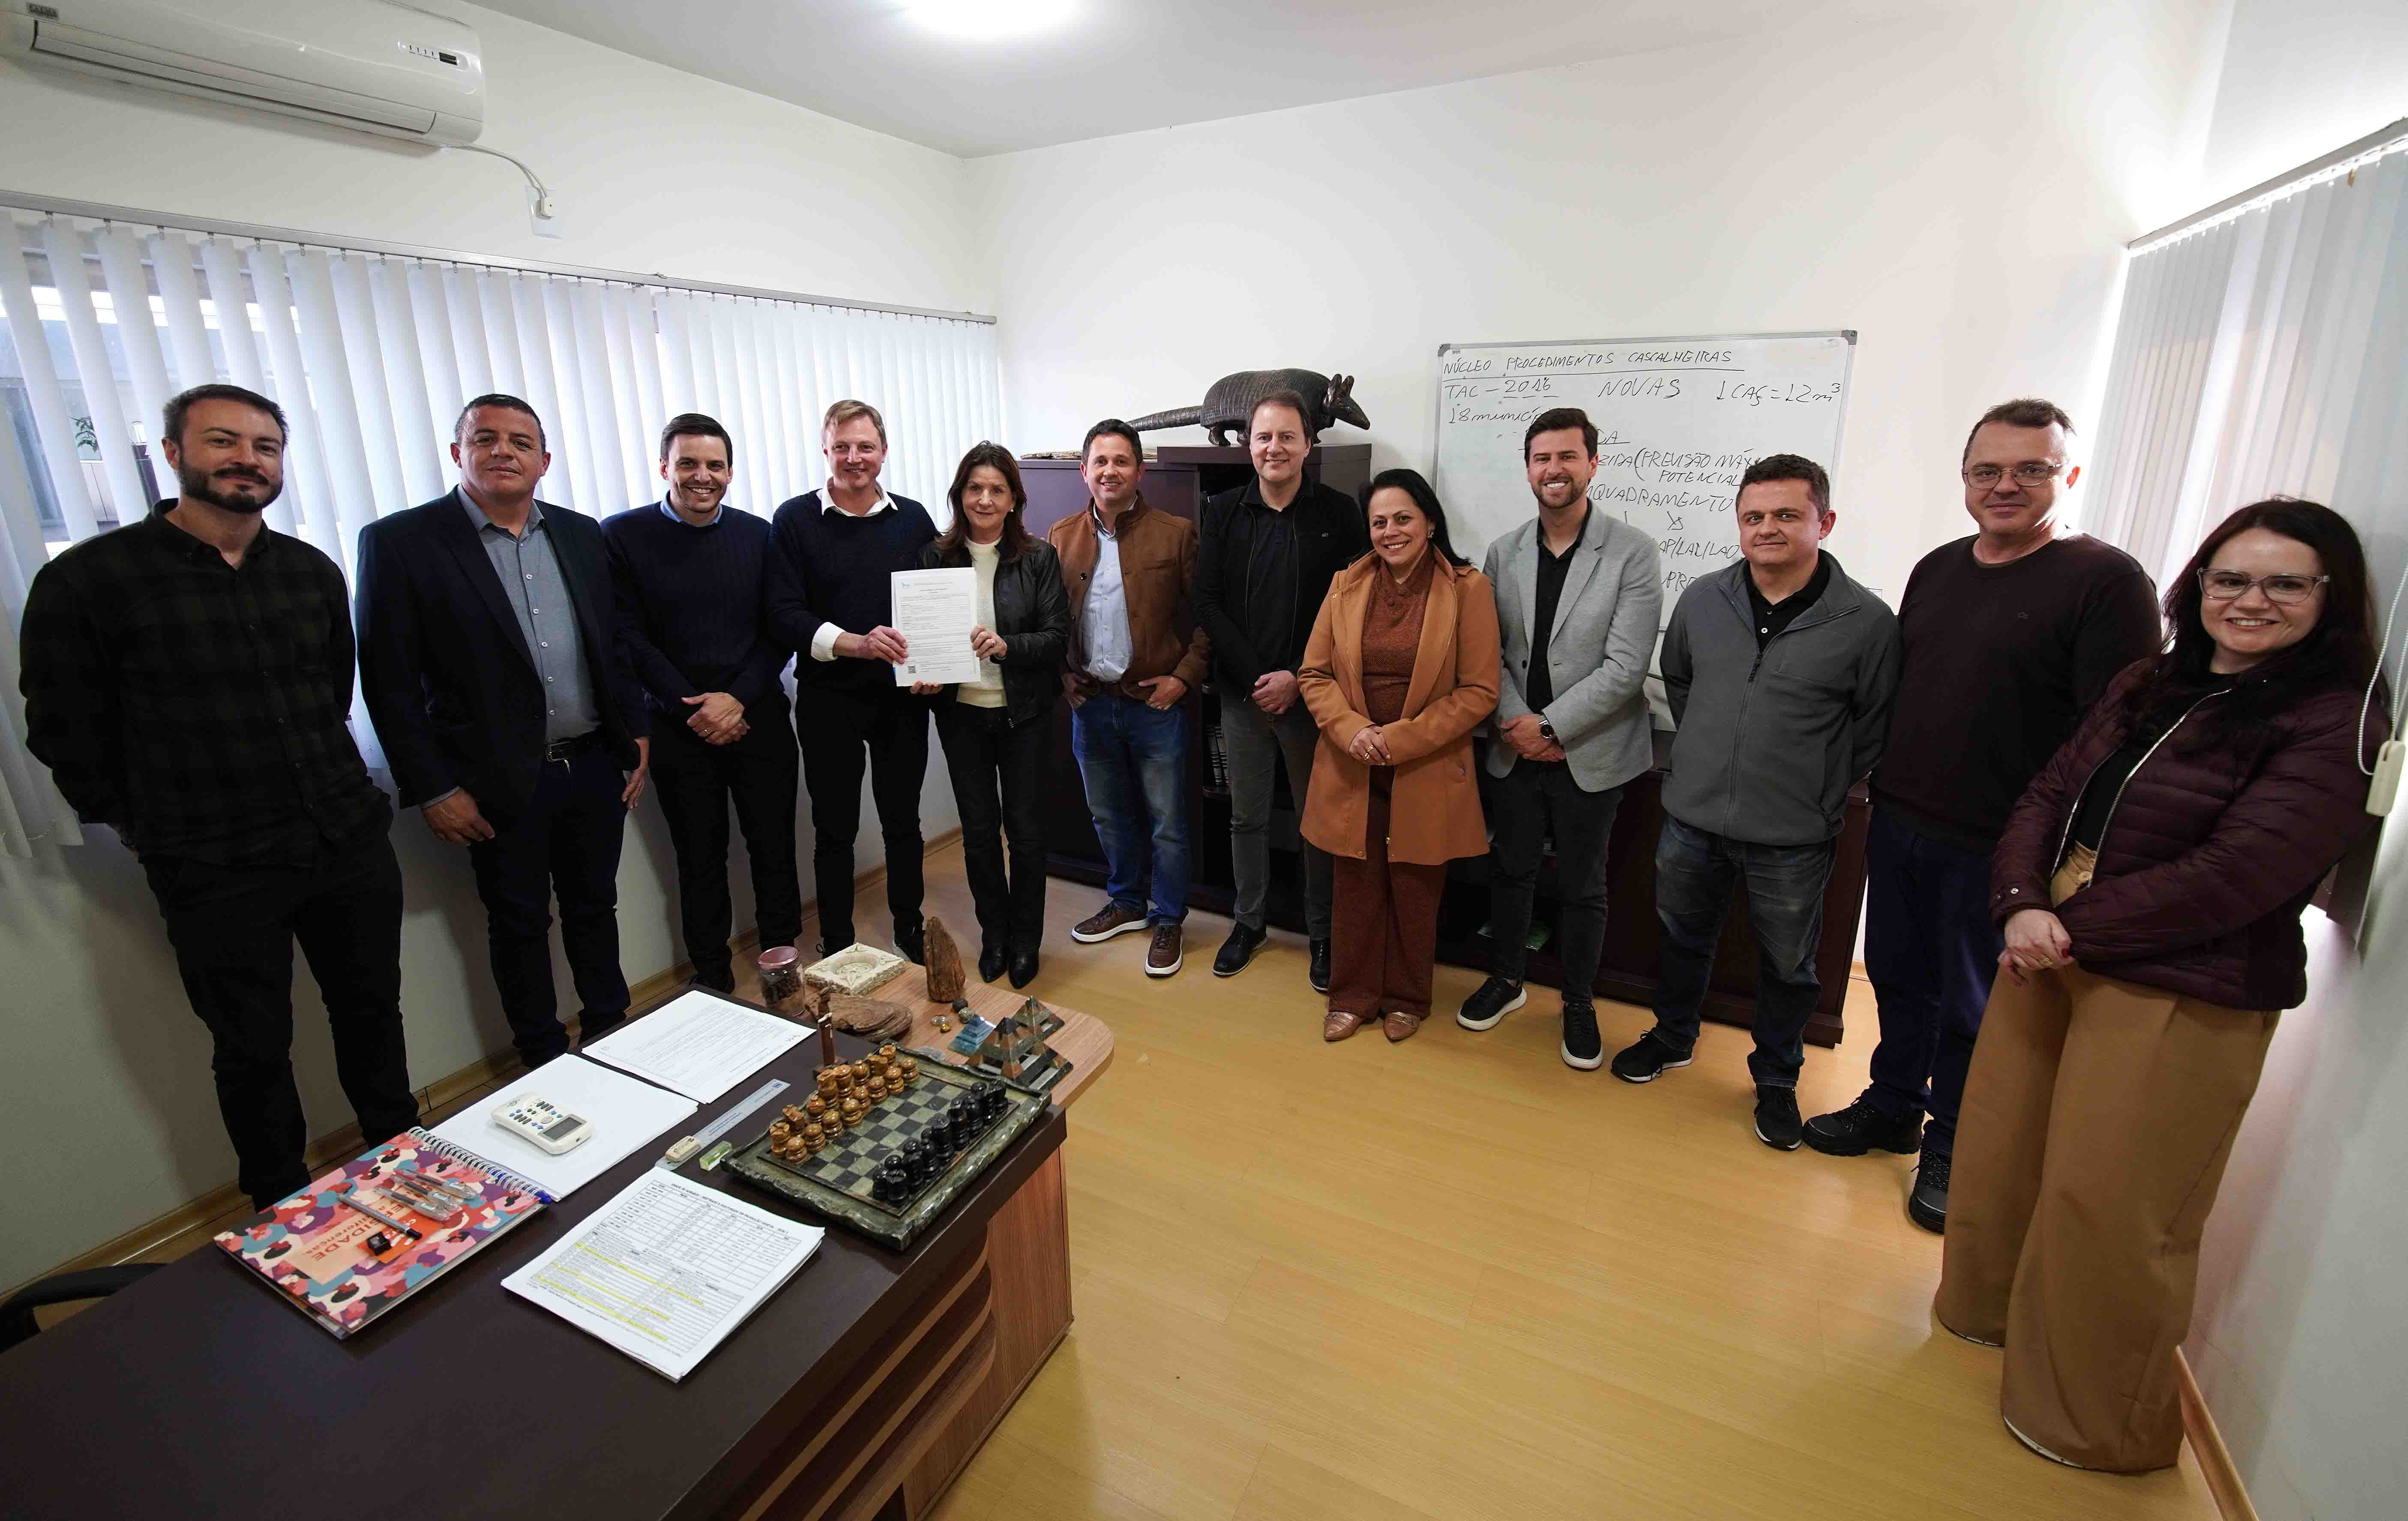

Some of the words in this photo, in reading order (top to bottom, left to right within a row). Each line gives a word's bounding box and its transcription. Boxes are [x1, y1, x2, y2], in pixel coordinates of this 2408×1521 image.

[1444, 357, 1491, 374] NÚCLEO
[1506, 353, 1614, 371] PROCEDIMENTOS
[1628, 350, 1732, 363] CASCALHEIRAS
[1444, 385, 1479, 399] TAC
[1504, 377, 1551, 392] 2016
[1598, 377, 1680, 398] NOVAS
[1714, 448, 1761, 470] MÁX
[1659, 470, 1741, 486] POTENCIAL
